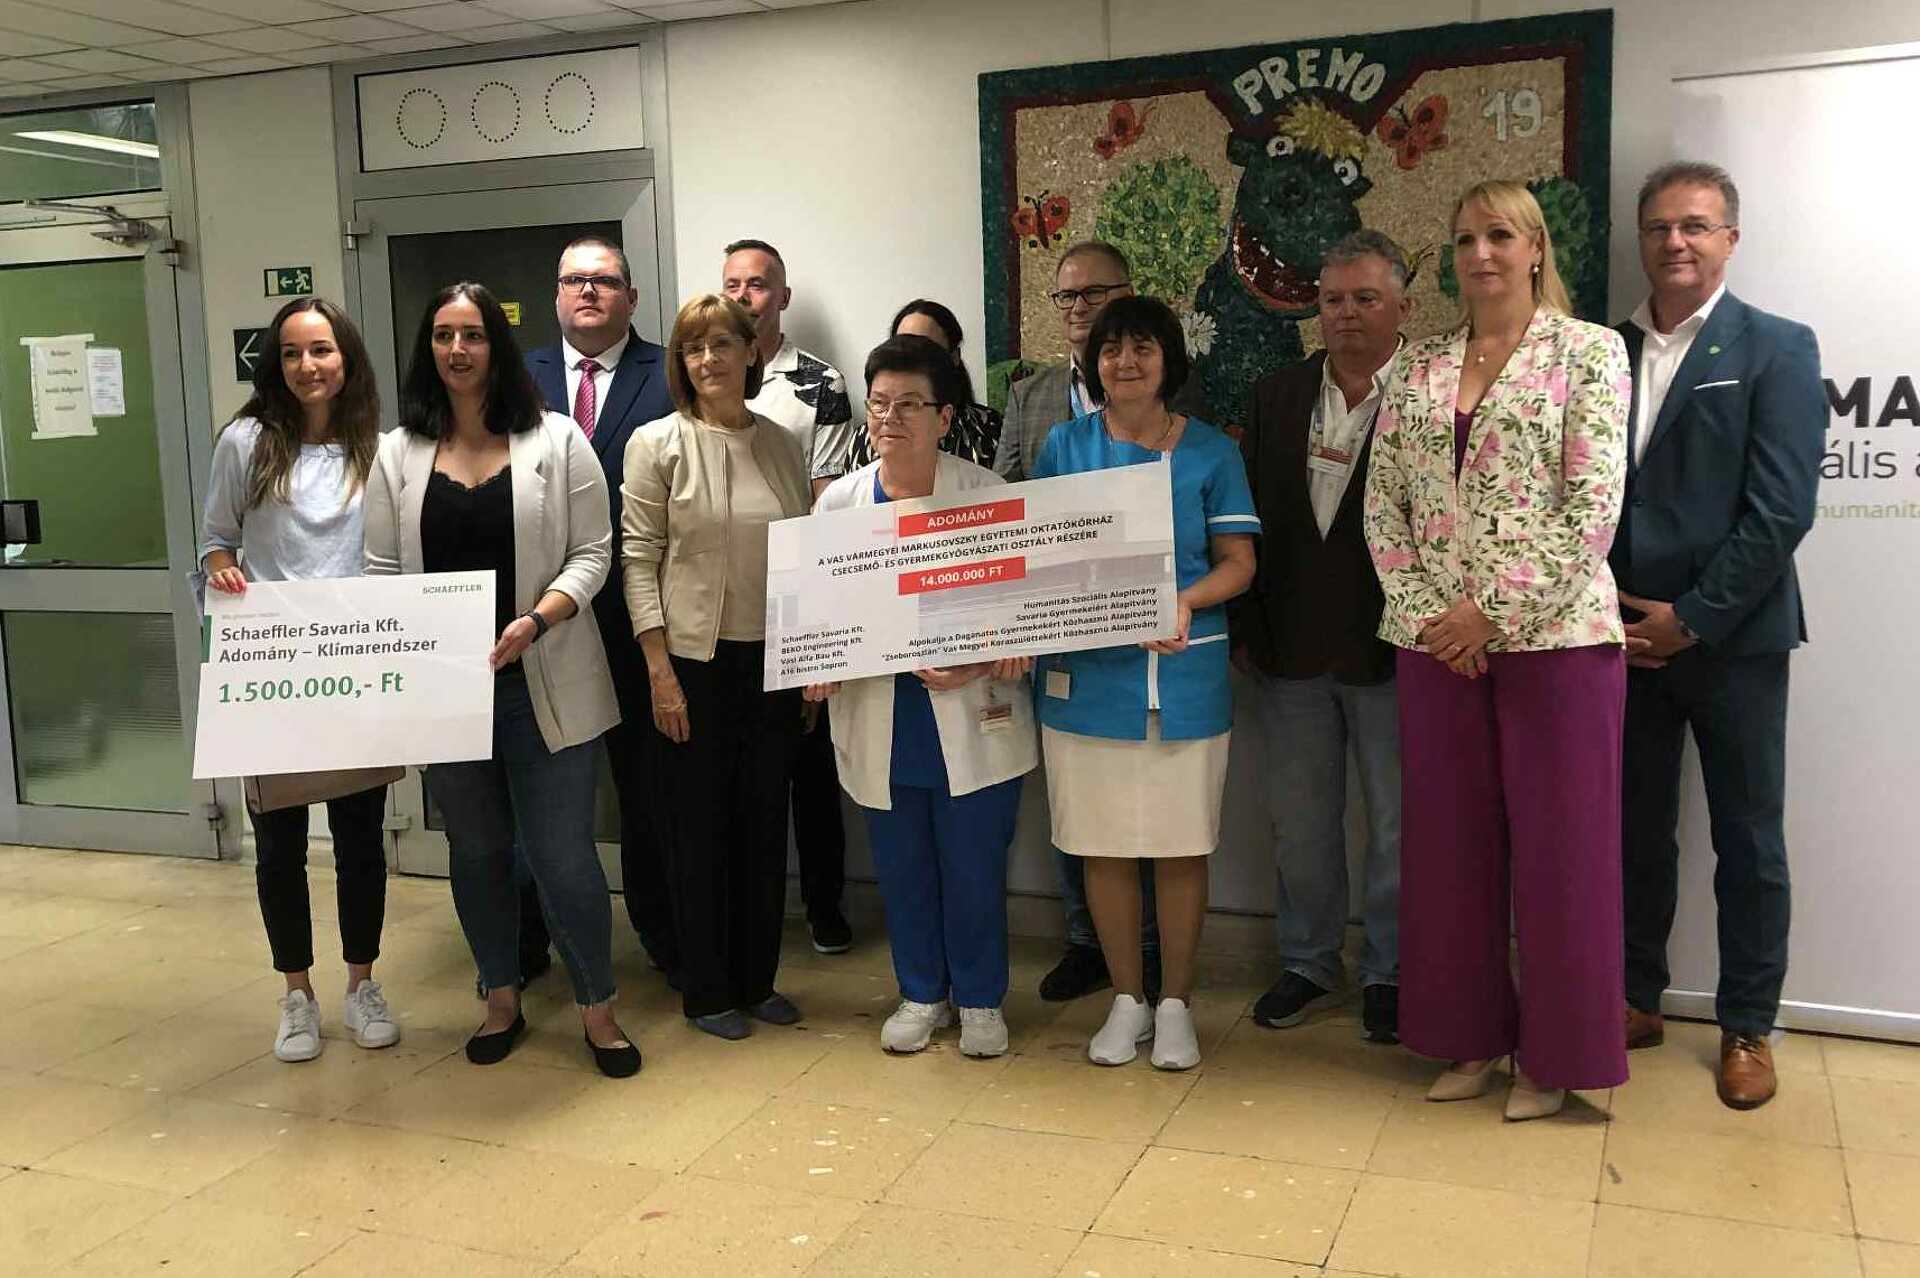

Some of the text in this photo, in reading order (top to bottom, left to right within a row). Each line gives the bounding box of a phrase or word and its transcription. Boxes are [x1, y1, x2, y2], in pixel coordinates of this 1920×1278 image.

[1233, 48, 1386, 115] PREMO
[927, 508, 995, 528] ADOMÁNY
[818, 515, 1113, 566] A VAS VÁRMEGYEI MARKUSOVSZKY EGYETEMI OKTATÓKÓRHÁZ
[885, 558, 895, 568] ÉS
[897, 543, 1009, 566] GYERMEKGYÓGYÁSZATI
[1011, 536, 1053, 550] OSZTÁLY
[1056, 530, 1097, 543] RÉSZÉRE
[920, 565, 1004, 587] 14.000.000 FT
[422, 584, 482, 594] SCHAEFFLER
[1024, 597, 1069, 610] Humanitás
[1016, 612, 1048, 622] Savaria
[221, 618, 404, 642] Schaeffler Savaria Kft.
[782, 633, 820, 644] Schaeffler
[821, 626, 849, 637] Savaria
[909, 634, 946, 648] Alpokalja
[955, 629, 998, 641] Daganatos
[219, 646, 297, 663] Adomány
[317, 638, 438, 657] Klímarendszer
[781, 645, 801, 655] BEKO
[803, 638, 848, 651] Engineering
[943, 645, 957, 653] Vas
[960, 640, 988, 653] Megyei
[219, 672, 404, 703] 1.500.000,- Ft
